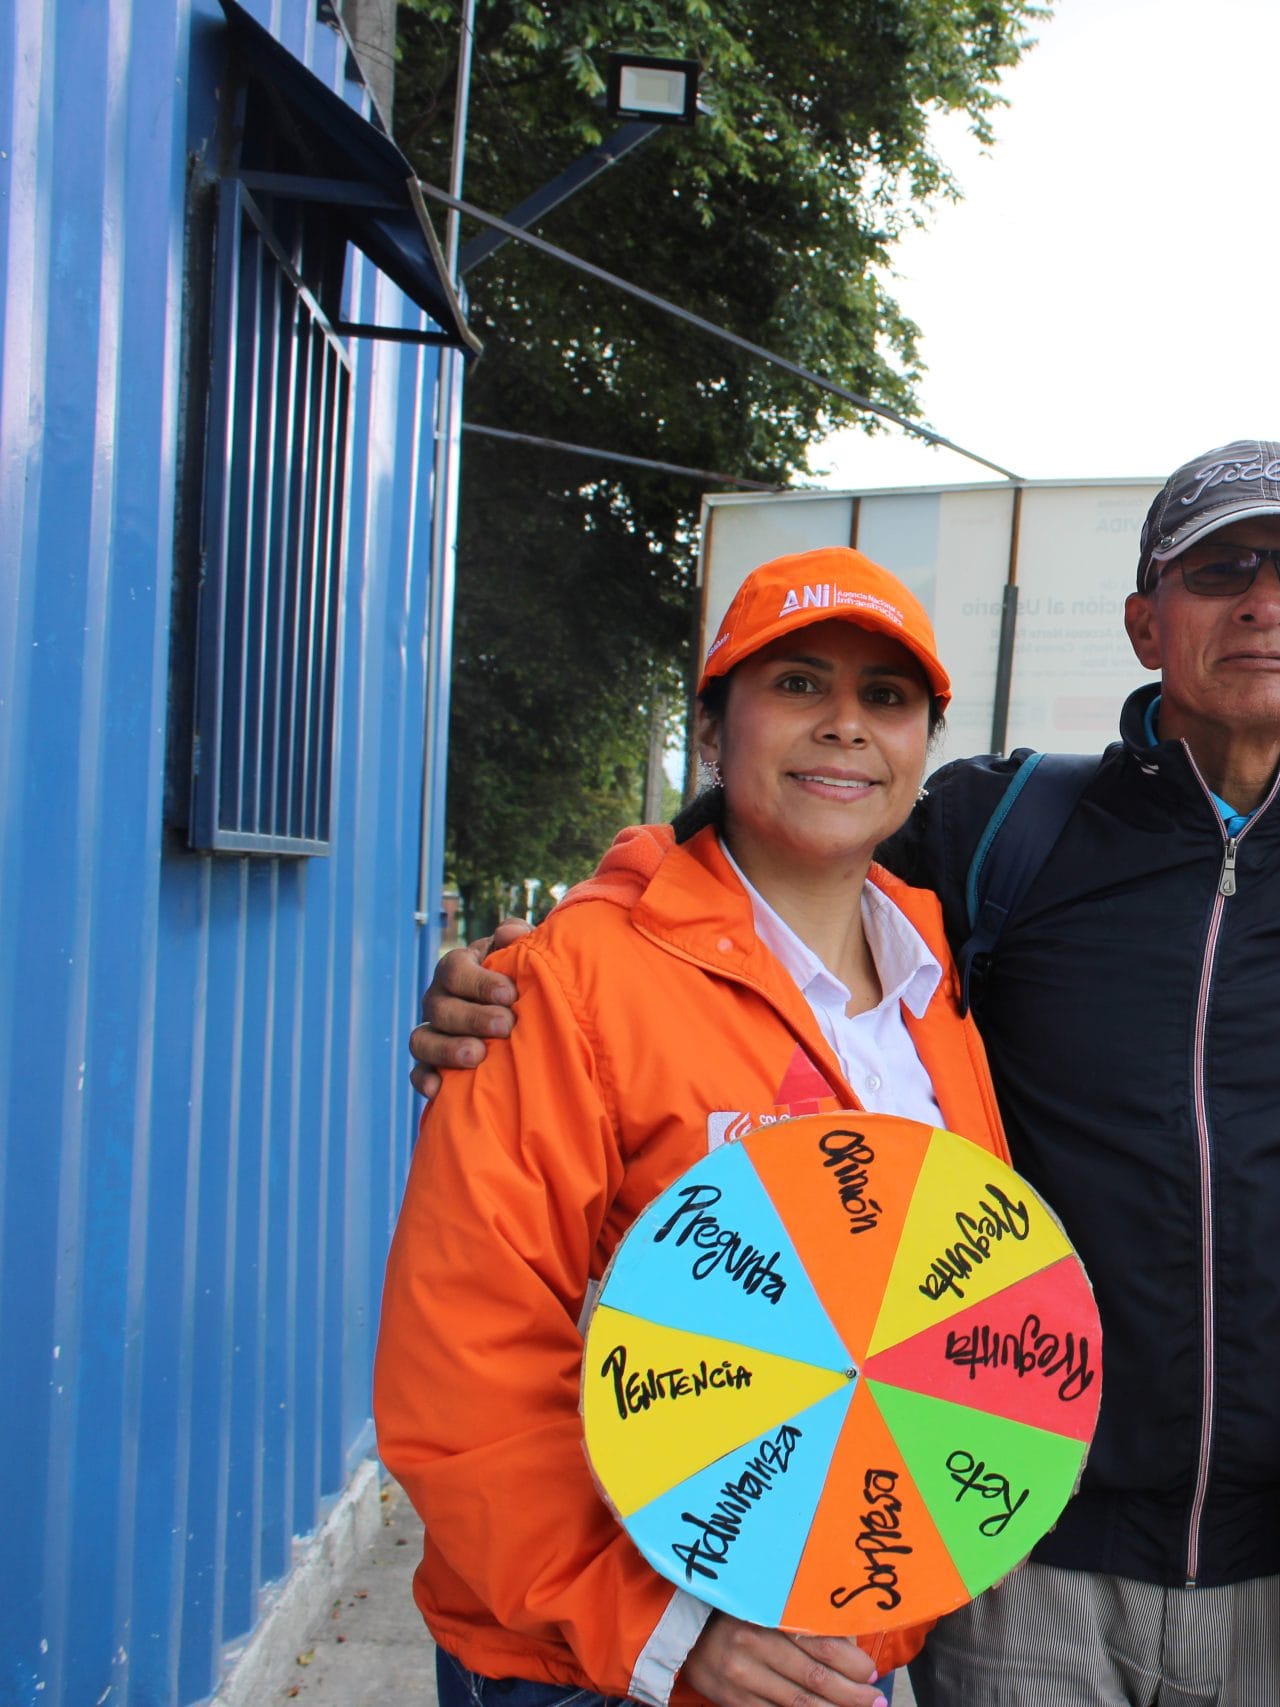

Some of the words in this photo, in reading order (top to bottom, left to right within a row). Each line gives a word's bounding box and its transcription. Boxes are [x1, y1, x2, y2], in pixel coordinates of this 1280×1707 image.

[653, 1184, 788, 1305] Pregunta
[918, 1183, 1031, 1301] Pregunta
[945, 1313, 1095, 1402] Pregunta
[830, 1468, 913, 1610] Sorpresa
[945, 1450, 1031, 1537] Reto
